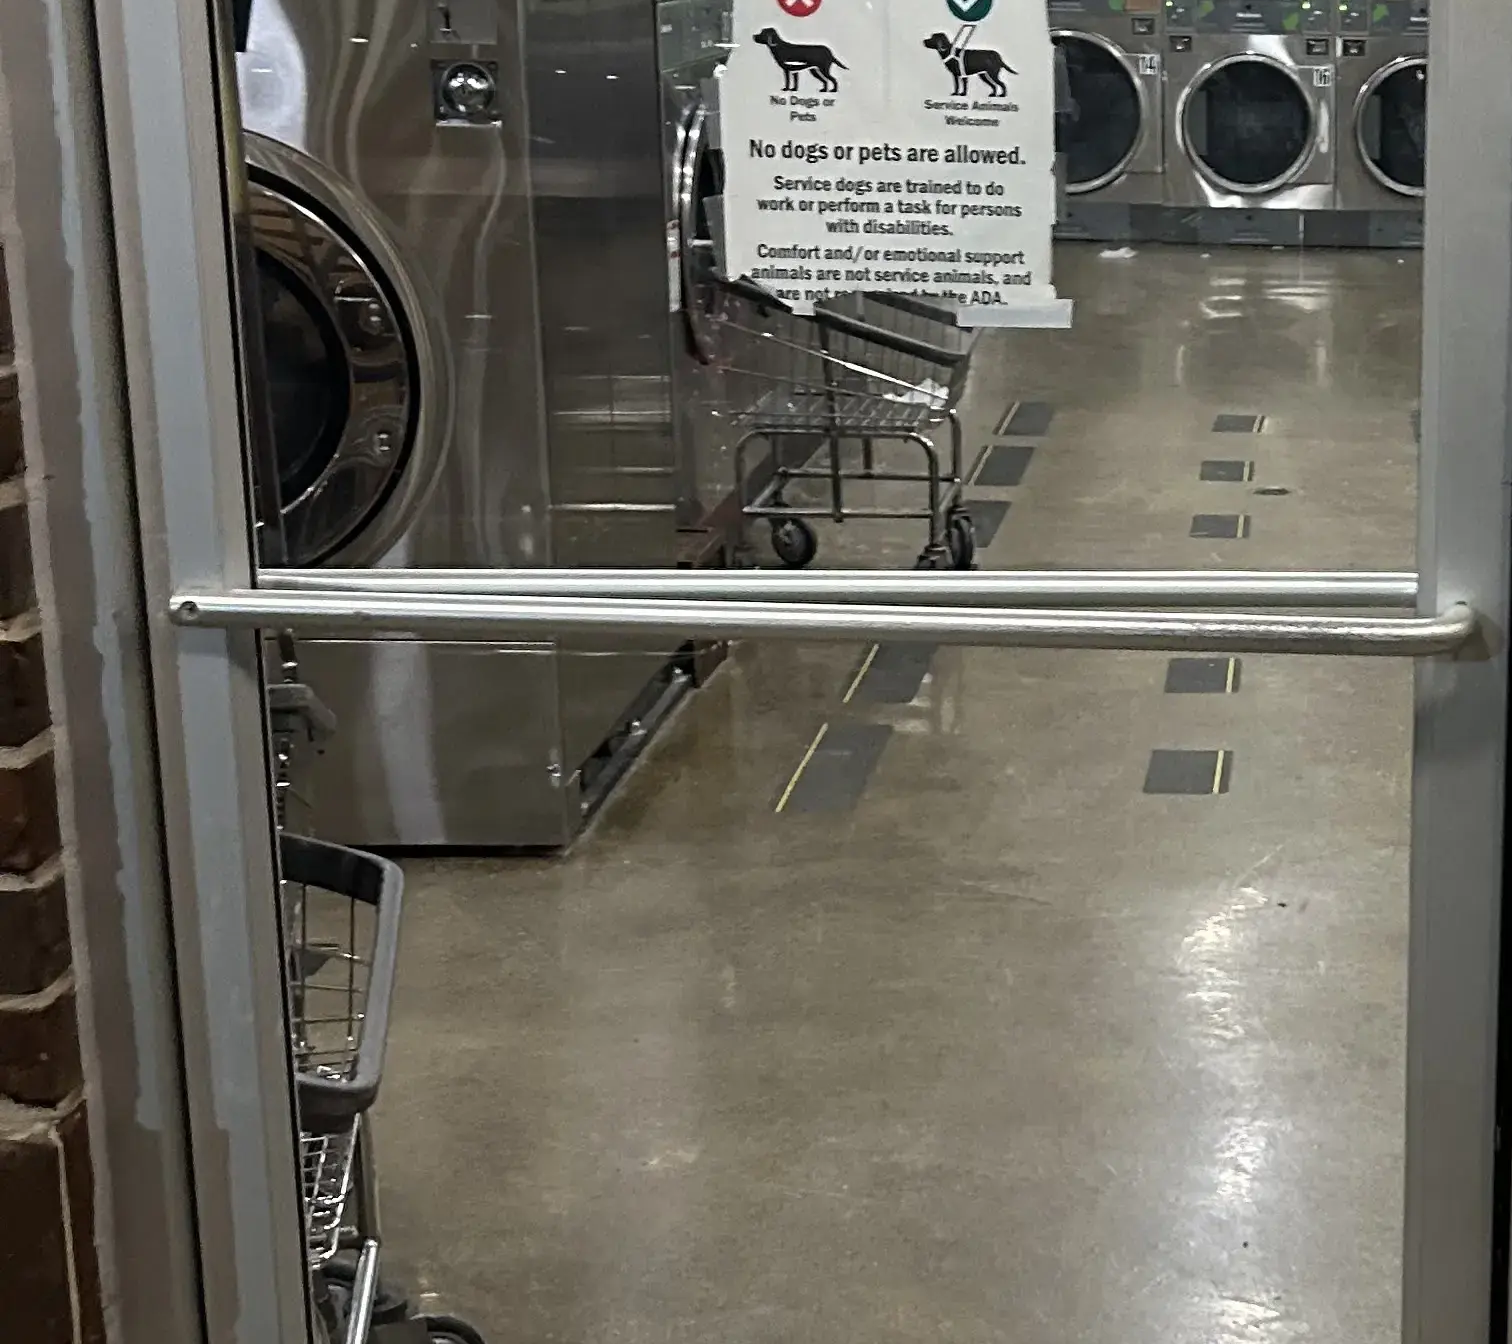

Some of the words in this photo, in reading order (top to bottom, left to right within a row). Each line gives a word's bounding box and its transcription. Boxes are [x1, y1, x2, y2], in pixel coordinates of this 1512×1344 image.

[770, 95, 787, 105] No
[790, 96, 820, 108] Dogs
[822, 98, 836, 106] or
[924, 99, 968, 111] Service
[971, 101, 1019, 112] Animals
[790, 111, 817, 122] Pets
[944, 115, 999, 127] Welcome
[750, 140, 776, 158] No
[781, 140, 828, 163] dogs
[833, 145, 854, 161] or
[859, 143, 902, 164] pets
[907, 147, 939, 163] are
[944, 145, 1026, 165] allowed.
[774, 175, 831, 192] Service
[835, 176, 873, 195] dogs
[876, 180, 902, 193] are
[906, 179, 962, 194] trained
[966, 182, 982, 195] to
[985, 182, 1004, 196] do
[757, 197, 795, 211] work
[798, 200, 815, 212] or
[818, 198, 880, 215] perform
[883, 201, 894, 213] a
[897, 200, 932, 214] task
[935, 200, 960, 215] for
[961, 203, 1022, 218] persons
[825, 219, 860, 234] with
[863, 220, 954, 236] disabilities.
[757, 244, 820, 259] Comfort
[824, 245, 880, 263] and/or
[883, 248, 961, 262] emotional
[964, 249, 1025, 267] support
[751, 265, 812, 280] animals
[816, 269, 841, 281] are
[845, 267, 871, 282] not
[874, 268, 930, 283] service
[933, 269, 999, 286] animals,
[1002, 271, 1032, 286] and
[775, 289, 800, 301] are
[804, 288, 831, 302] not
[970, 290, 1009, 306] ADA.
